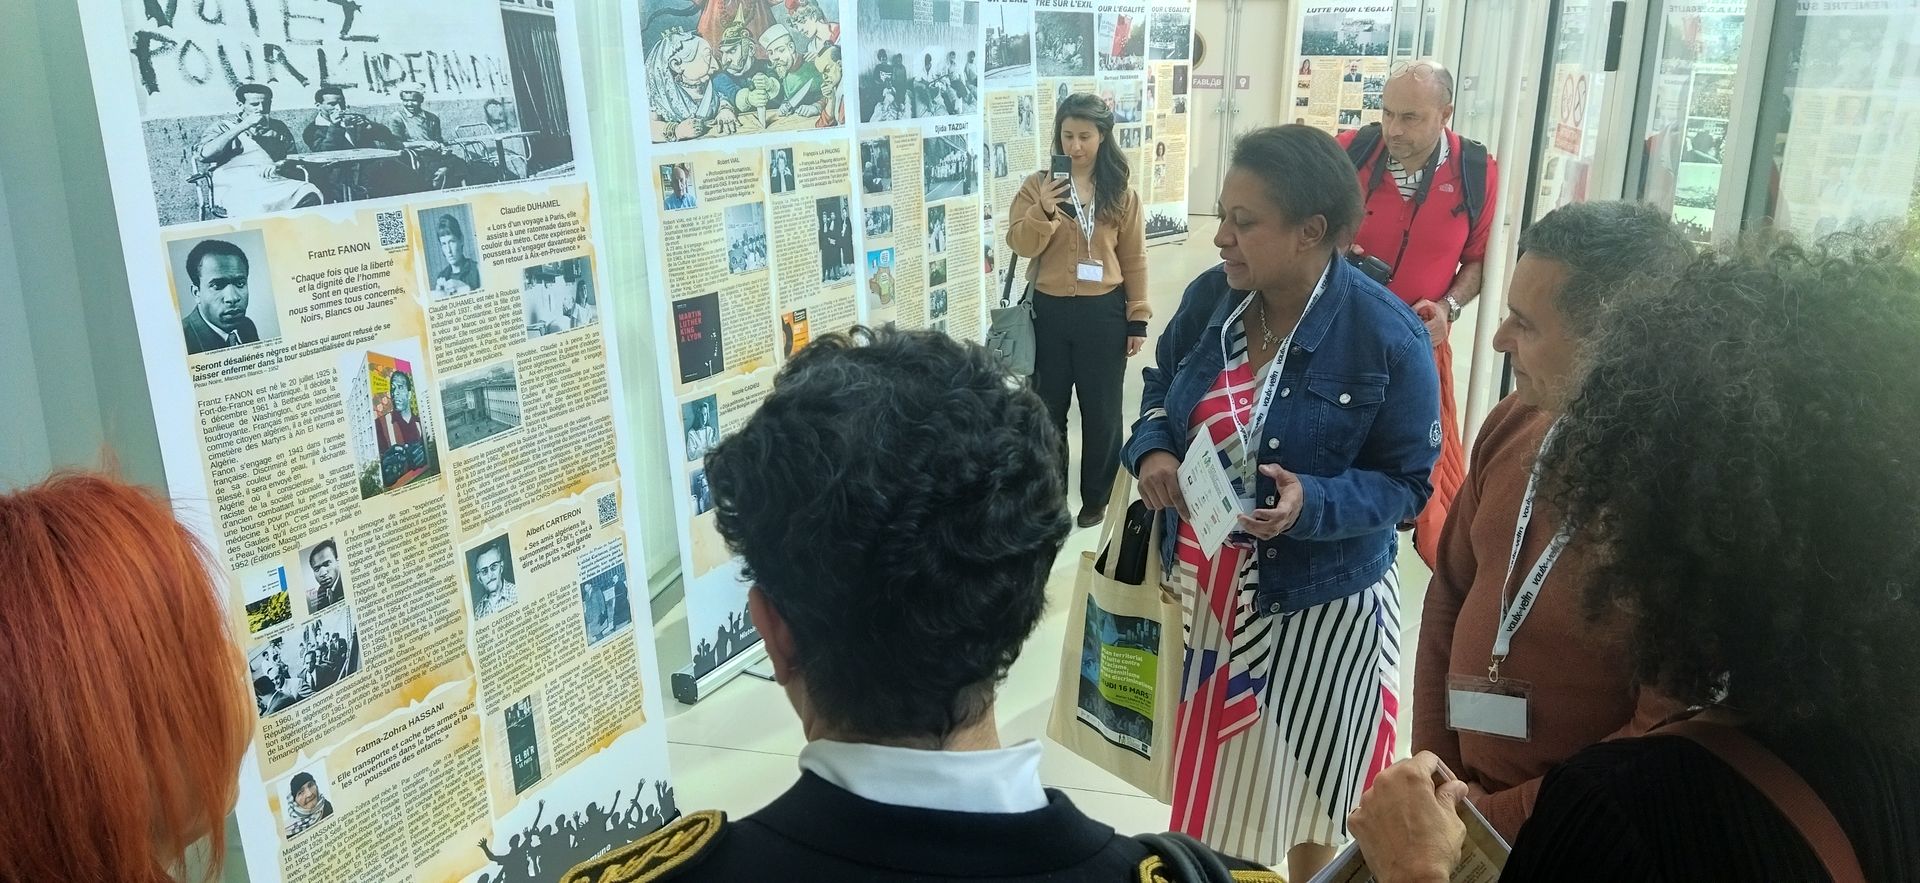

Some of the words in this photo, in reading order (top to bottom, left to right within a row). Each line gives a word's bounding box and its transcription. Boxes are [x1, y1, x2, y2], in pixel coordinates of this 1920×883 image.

[131, 30, 310, 96] POUR
[500, 205, 526, 215] Claudie
[527, 200, 560, 211] DUHAMEL
[522, 217, 544, 226] voyage
[549, 213, 566, 221] Paris,
[481, 240, 503, 251] couloir
[513, 236, 532, 244] métro.
[533, 233, 549, 241] Cette
[550, 228, 580, 238] expérience
[486, 231, 508, 241] assiste
[527, 223, 556, 233] ratonnade
[308, 249, 336, 260] Frantz
[338, 242, 370, 254] FANON
[482, 249, 511, 261] poussera
[517, 242, 546, 253] s'engager
[547, 237, 576, 249] davantage
[505, 255, 523, 263] retour
[530, 243, 576, 258] Aix-en-Provence
[326, 268, 342, 277] fois
[343, 266, 359, 276] que
[360, 263, 368, 271] la
[370, 258, 394, 270] liberté
[307, 283, 315, 291] la
[314, 277, 343, 290] dignité
[345, 274, 356, 284] de
[357, 270, 390, 282] l'homme
[312, 288, 330, 300] Sont
[343, 282, 380, 296] question,
[289, 306, 308, 316] nous
[310, 299, 342, 311] sommes
[344, 295, 362, 304] tous
[364, 287, 405, 300] concernés,
[300, 313, 323, 323] Noirs,
[325, 307, 352, 318] Blancs
[223, 352, 264, 366] désaliénés
[266, 347, 289, 357] nègres
[298, 339, 319, 349] blancs
[319, 335, 330, 345] qui
[330, 331, 352, 341] auront
[352, 326, 373, 336] refusé
[192, 371, 219, 382] laisser
[221, 363, 256, 375] enfermer
[257, 358, 275, 367] dans
[275, 355, 283, 363] la
[284, 353, 298, 361] tour
[299, 341, 345, 358] substantialisée
[526, 524, 545, 537] Albert
[546, 508, 581, 528] CARTERON
[1130, 687, 1148, 698] MARS
[356, 724, 407, 755] Fatma-Zohra
[408, 702, 444, 727] HASSANI
[341, 779, 353, 789] les
[354, 754, 397, 781] couvertures
[398, 743, 416, 756] dans
[425, 723, 452, 742] berceau
[453, 718, 460, 726] et
[364, 761, 400, 786] poussette
[402, 752, 415, 764] des
[416, 738, 444, 755] enfants.
